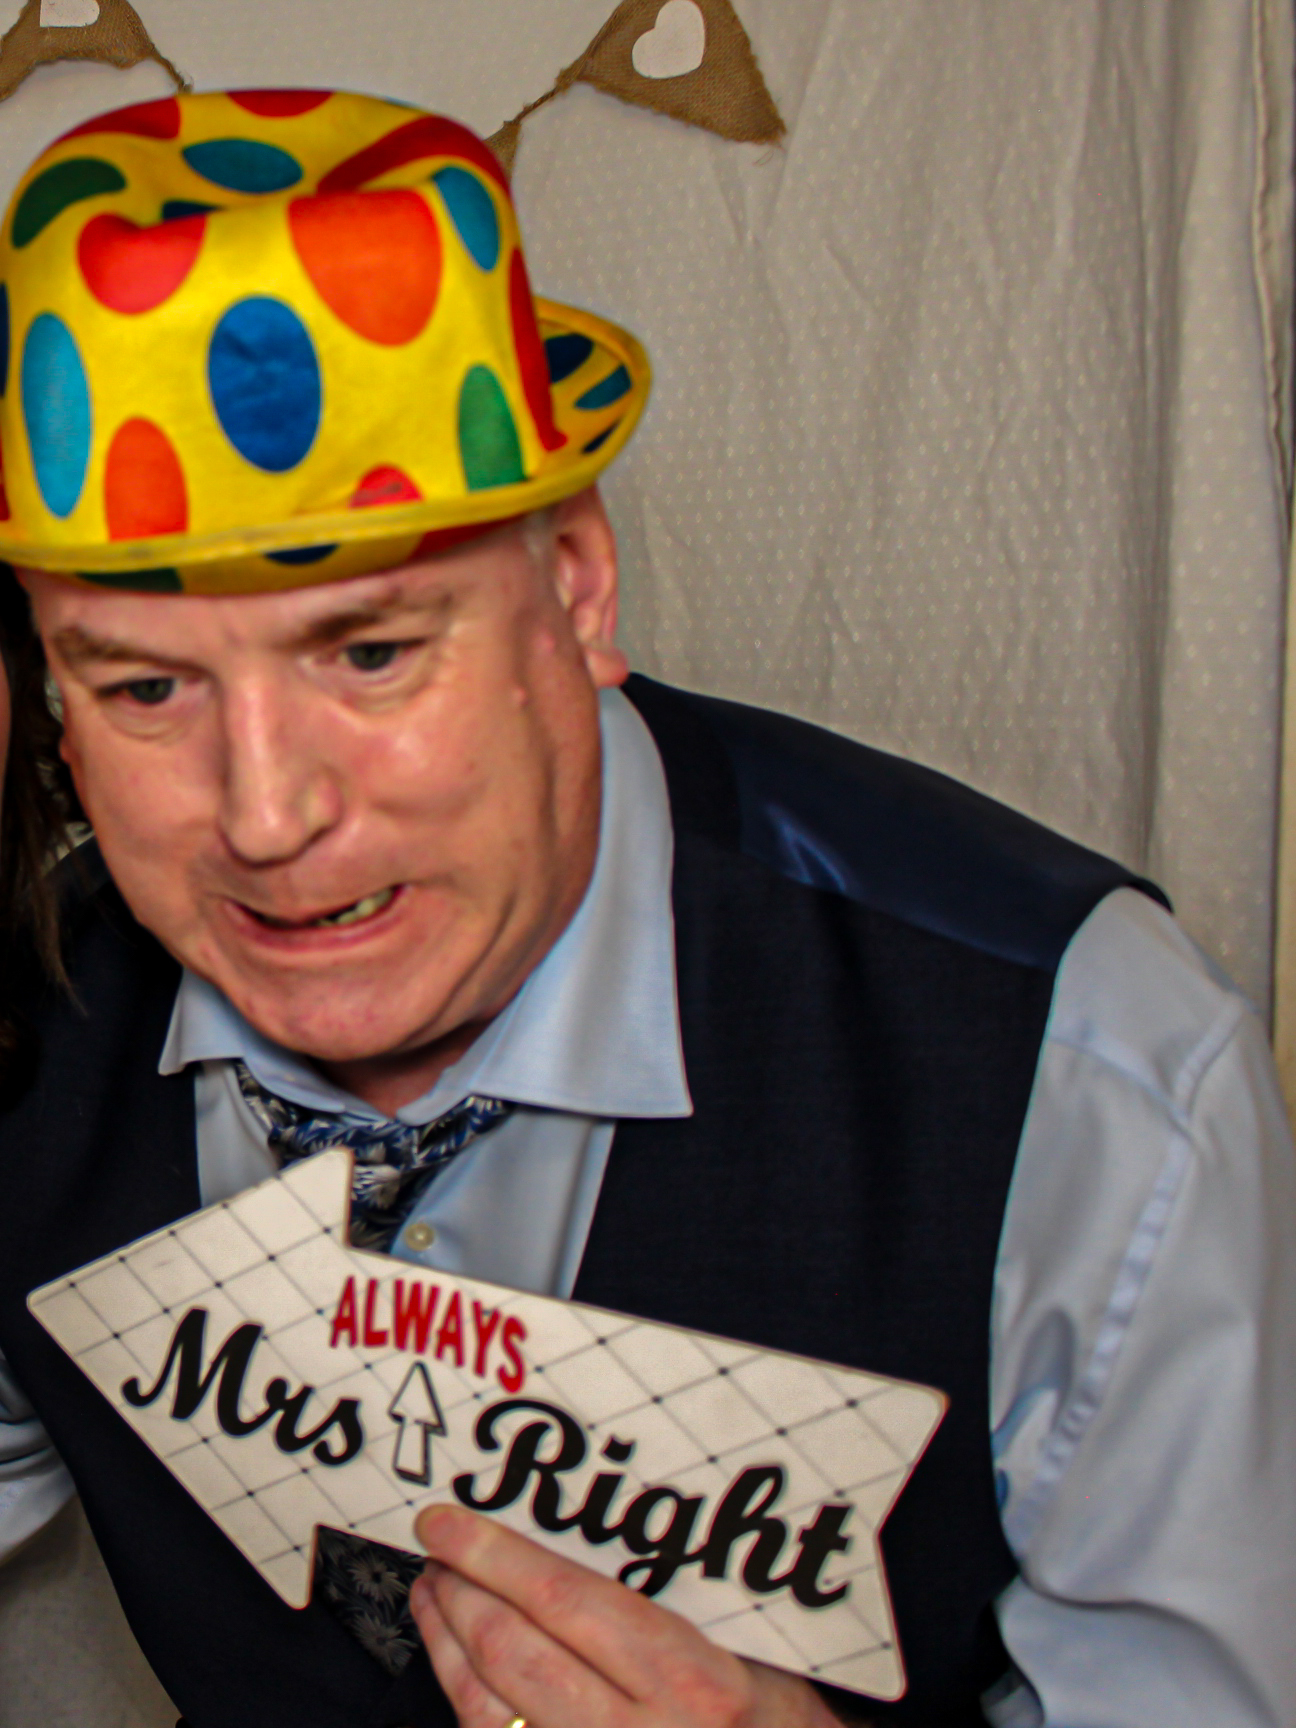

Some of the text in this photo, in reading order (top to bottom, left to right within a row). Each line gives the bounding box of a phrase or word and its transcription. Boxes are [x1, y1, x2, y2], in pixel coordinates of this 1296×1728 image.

[328, 1275, 529, 1394] ALWAYS
[121, 1307, 855, 1609] Mrs Right
